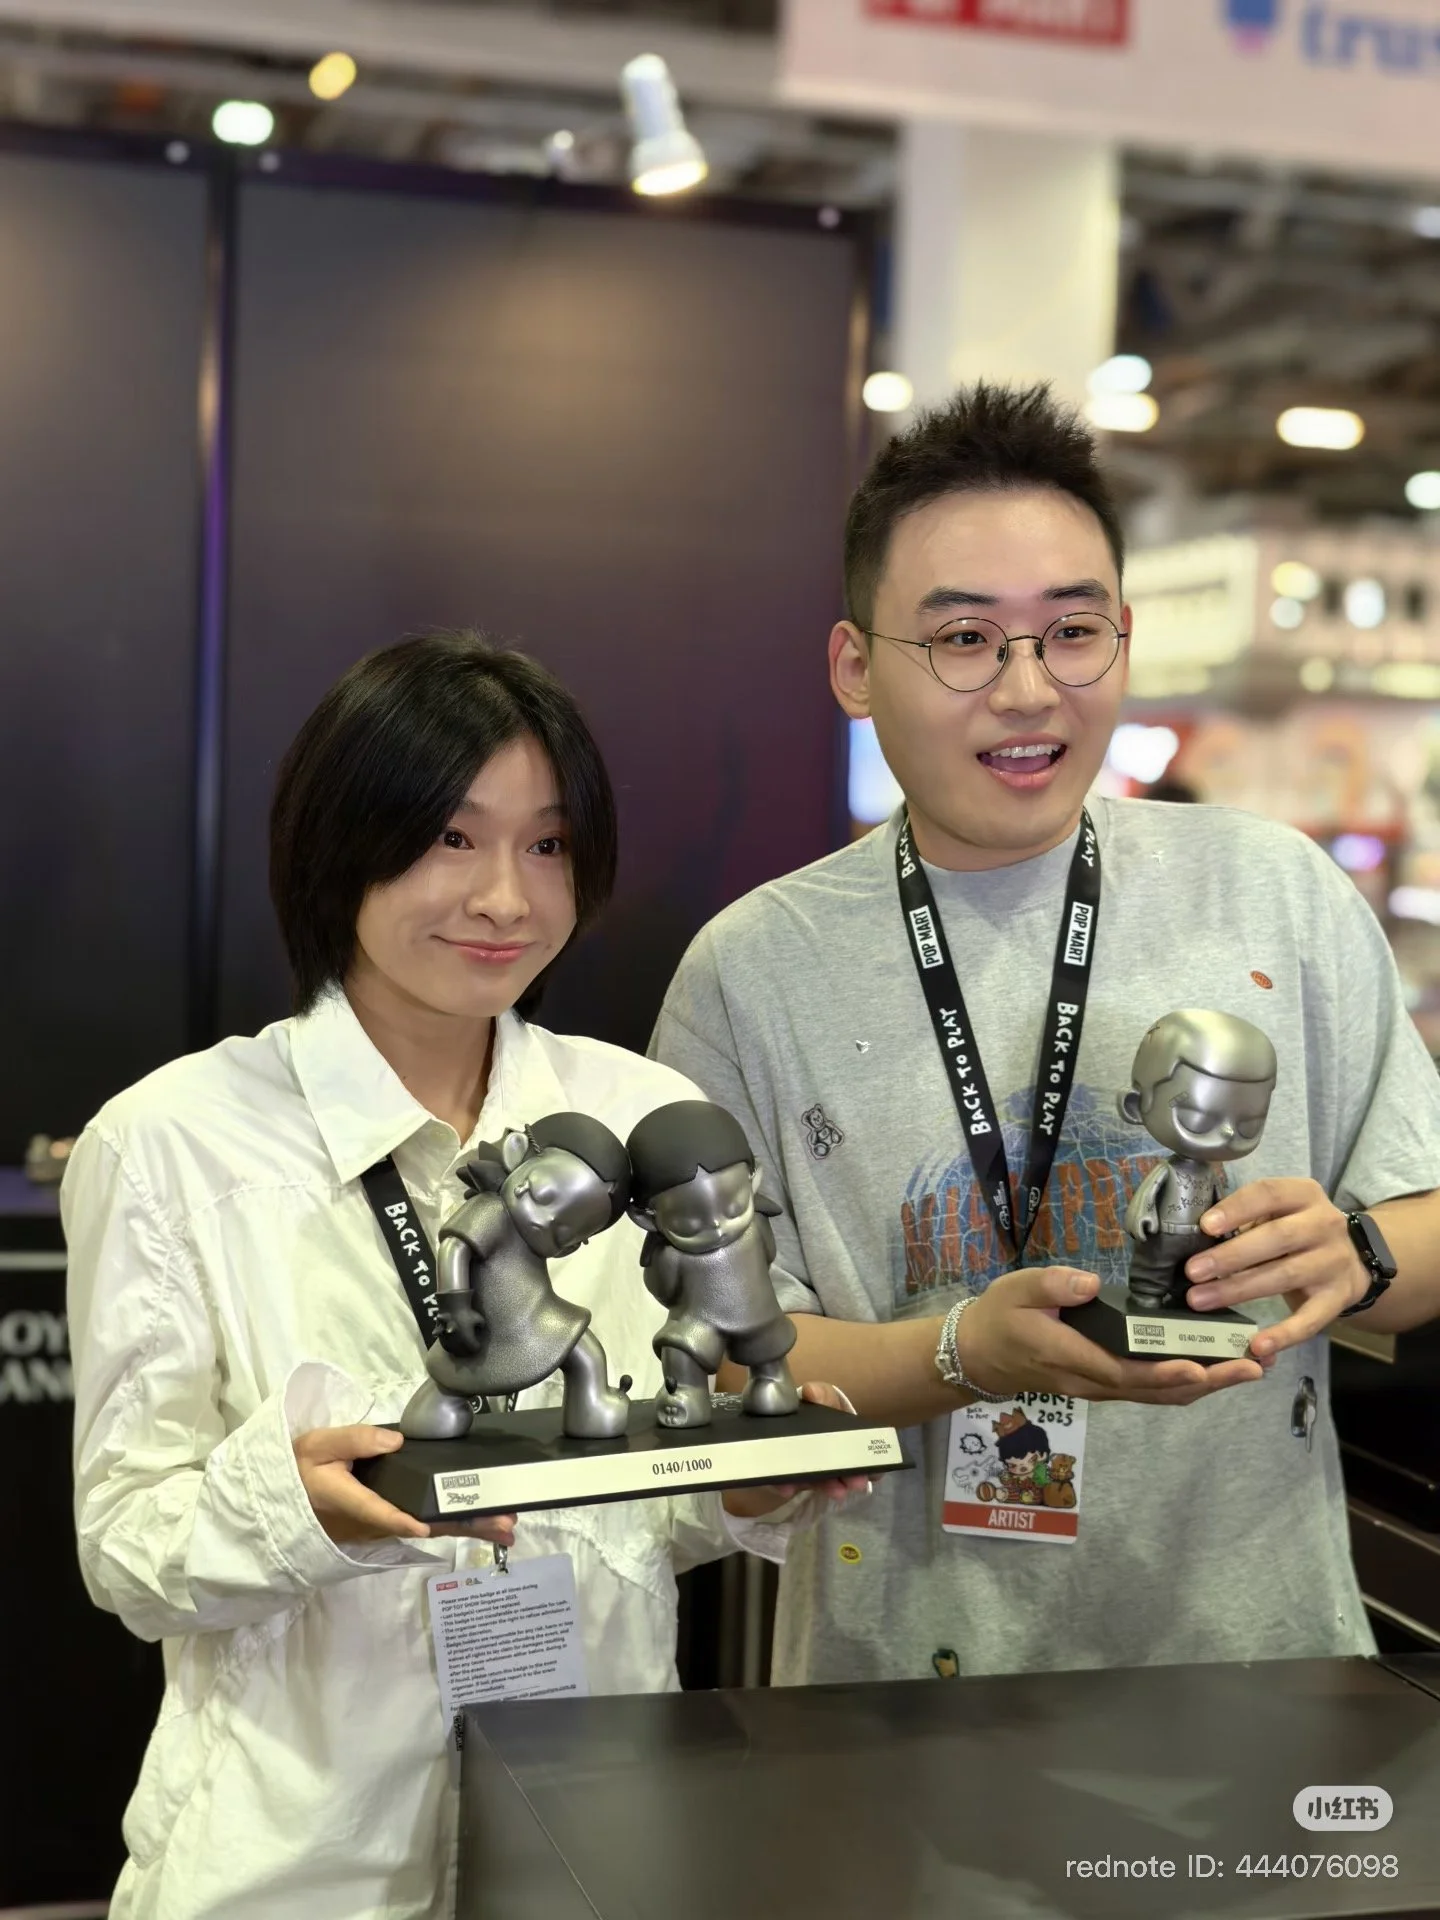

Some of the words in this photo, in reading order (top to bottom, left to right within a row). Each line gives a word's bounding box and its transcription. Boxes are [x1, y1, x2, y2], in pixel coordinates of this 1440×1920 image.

[1081, 828, 1096, 867] PLAY
[913, 911, 933, 941] MART
[1074, 905, 1090, 928] POP
[921, 944, 941, 965] POP
[1068, 930, 1086, 963] MART
[939, 1008, 965, 1048] PLAY
[1054, 1002, 1079, 1053] BACK
[962, 1083, 992, 1135] BACK
[1039, 1092, 1061, 1135] PLAY
[384, 1202, 420, 1256] BACK
[422, 1294, 439, 1321] PL
[1178, 1334, 1215, 1343] 0140/2000
[1038, 1410, 1073, 1426] 2025
[458, 1475, 477, 1487] MART
[652, 1458, 712, 1475] 0140/1000
[988, 1509, 1036, 1529] ARTIST
